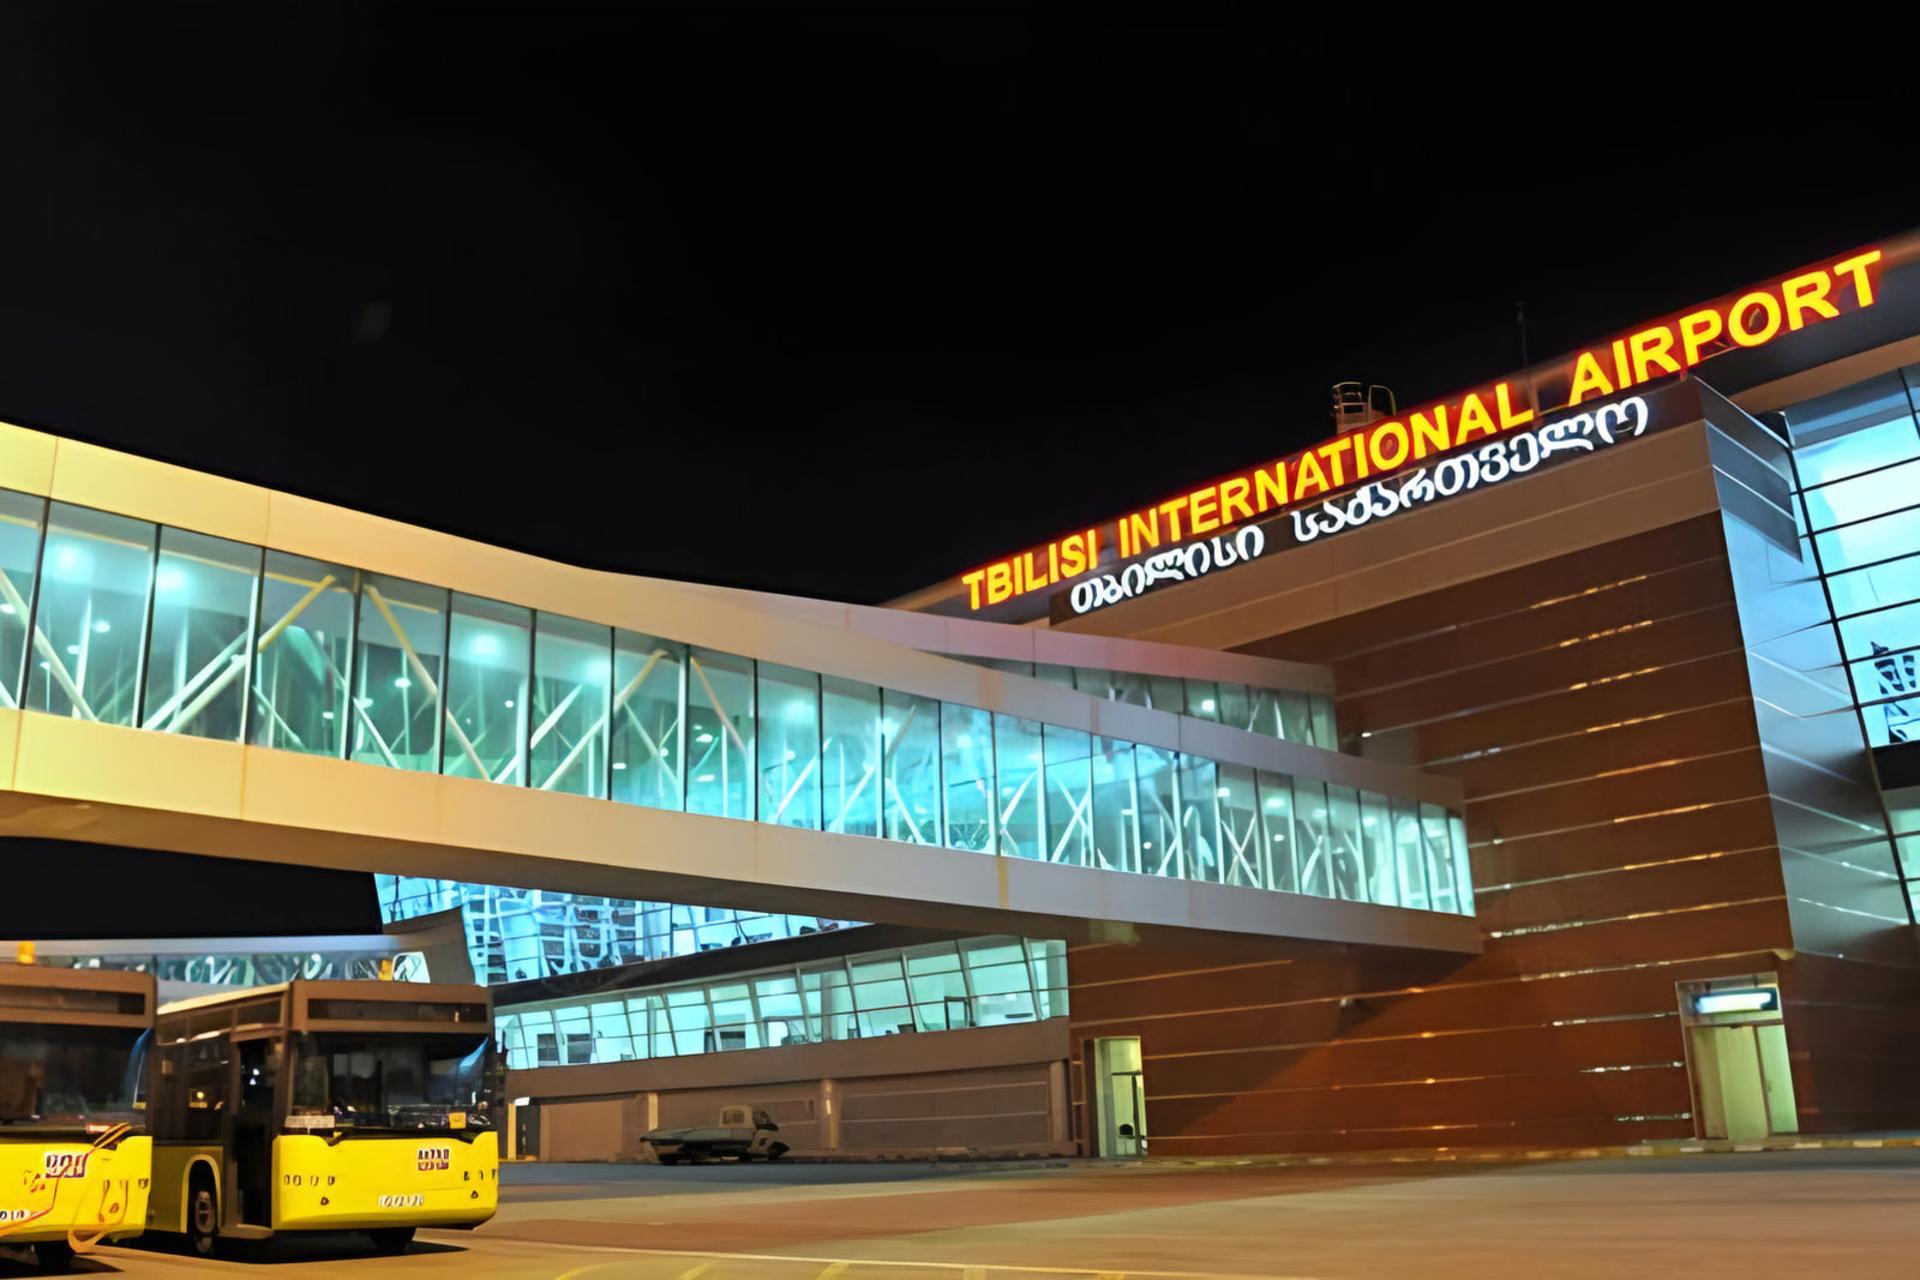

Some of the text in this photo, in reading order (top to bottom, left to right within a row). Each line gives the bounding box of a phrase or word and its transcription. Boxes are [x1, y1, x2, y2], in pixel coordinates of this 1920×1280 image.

[961, 249, 1882, 611] TBILISI INTERNATIONAL AIRPORT
[1069, 395, 1649, 614] თბილისი საქართველო
